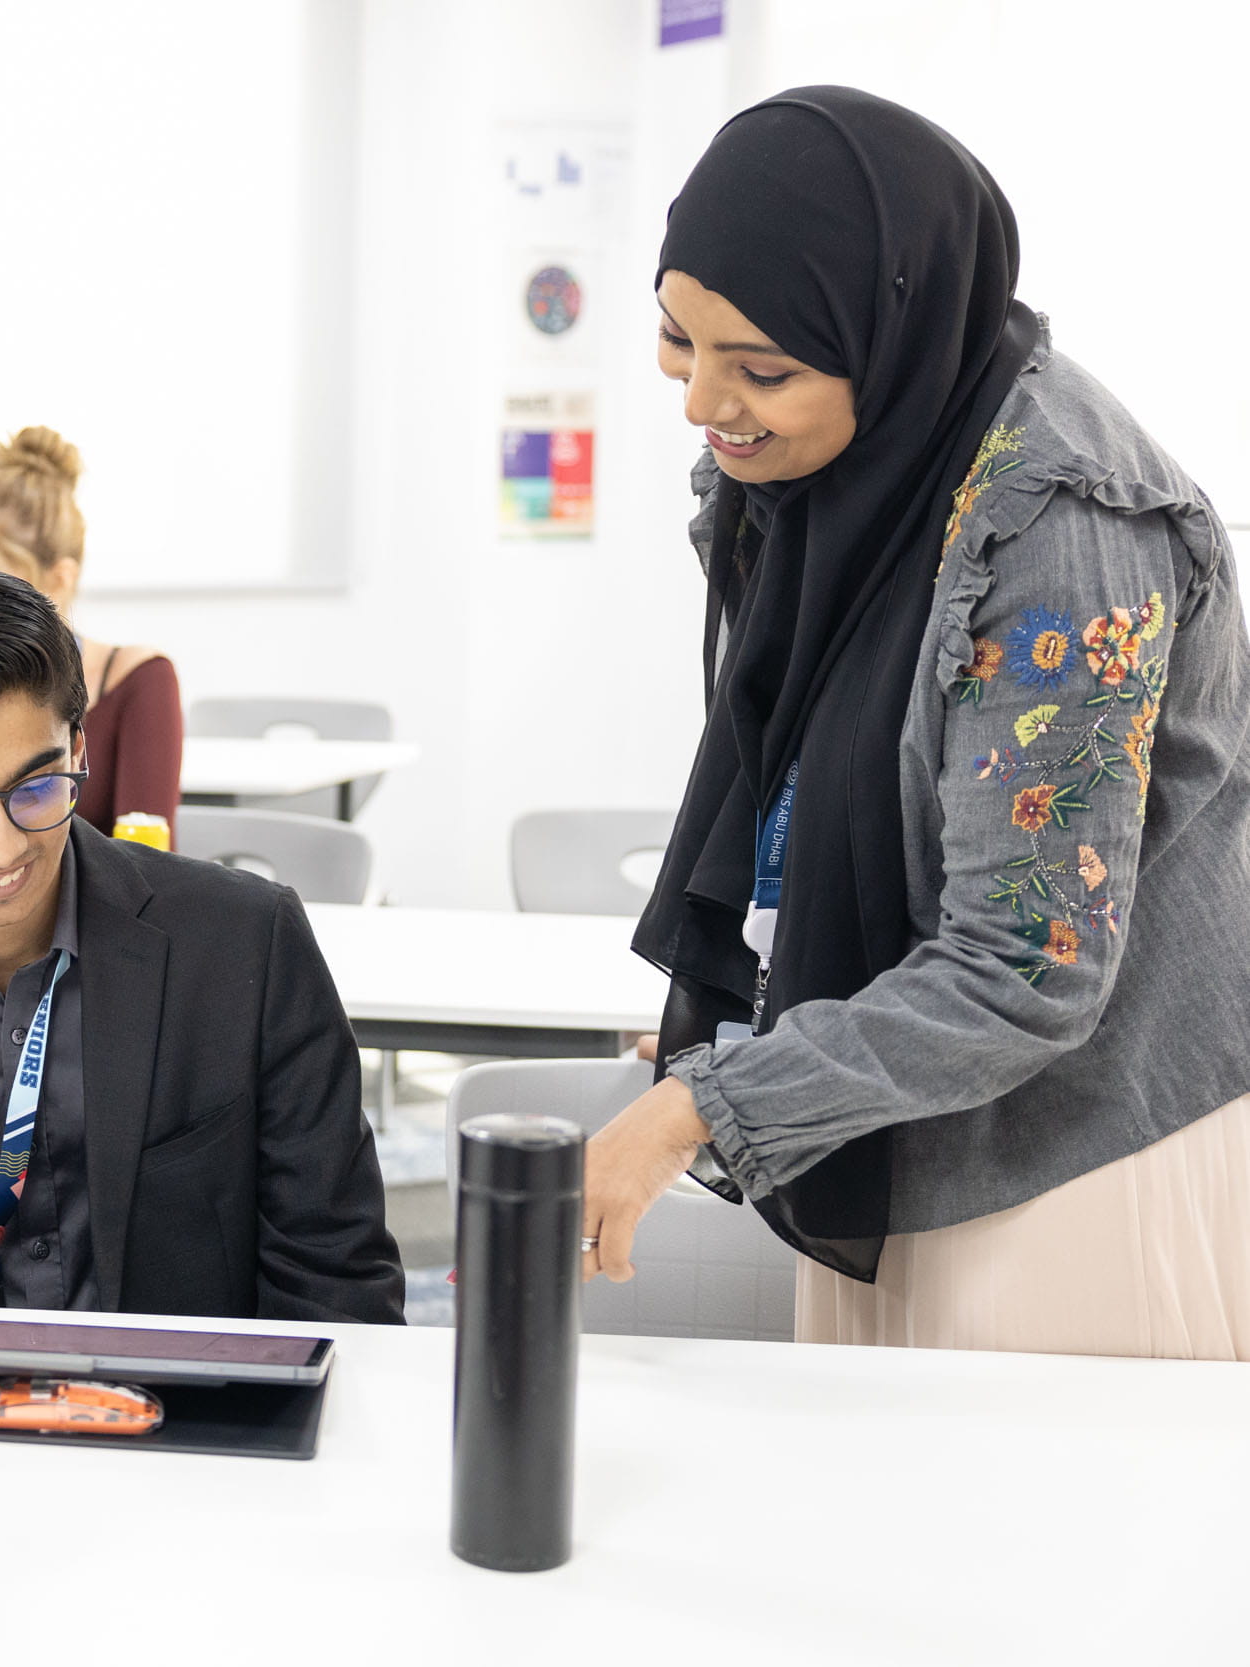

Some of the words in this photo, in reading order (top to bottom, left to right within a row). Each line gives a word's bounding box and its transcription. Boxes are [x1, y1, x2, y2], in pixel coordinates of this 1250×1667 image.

[780, 787, 793, 807] BIS
[774, 807, 789, 832] ABU
[768, 833, 784, 866] DHABI
[19, 990, 50, 1089] ENIORS
